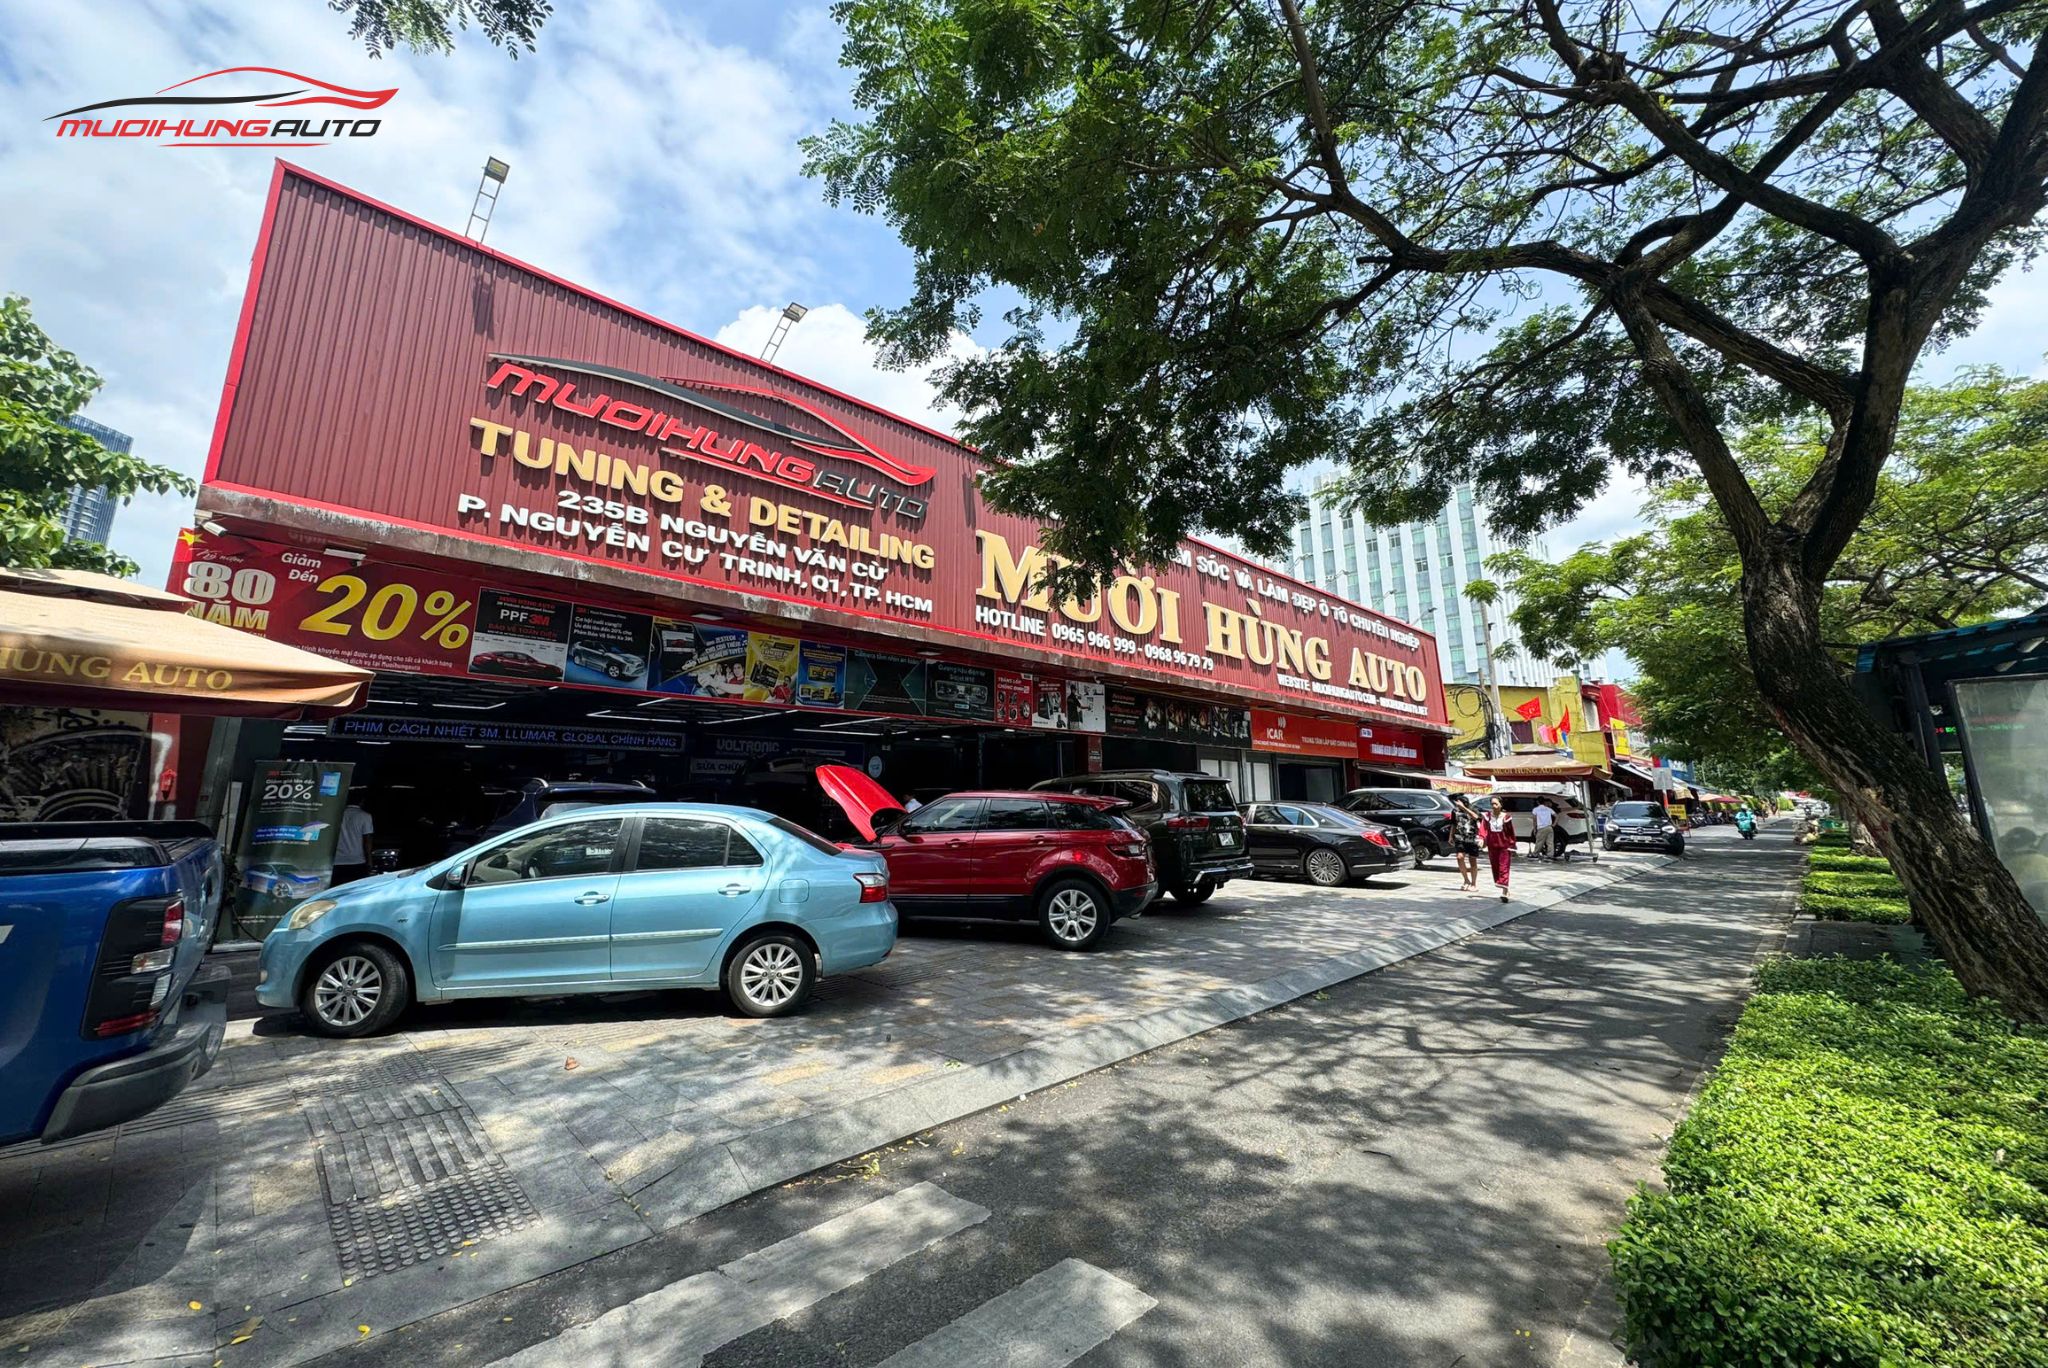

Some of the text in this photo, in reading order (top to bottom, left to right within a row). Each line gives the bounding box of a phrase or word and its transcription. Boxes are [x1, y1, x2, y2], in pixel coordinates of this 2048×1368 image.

[469, 417, 935, 570] TUNING & DETAILING
[457, 493, 491, 519] P.
[500, 503, 650, 554] NGUYỄN
[720, 552, 808, 589] TRINH,
[885, 590, 933, 613] HCM
[557, 489, 890, 581] 235B NGUYỄN VĂN CỪ
[183, 560, 277, 605] 80
[281, 552, 322, 569] Giảm
[288, 569, 319, 583] Đến
[299, 573, 473, 650] 20%
[500, 609, 551, 627] PPF 3M
[1196, 554, 1230, 581] SÓC
[1233, 567, 1254, 592] VÀ
[1257, 578, 1289, 604] LÀM
[1291, 591, 1317, 615] ĐẸP
[1319, 599, 1330, 617] Ô
[1331, 606, 1348, 624] TÔ
[1350, 613, 1389, 639] CHUYÊN
[1389, 628, 1420, 652] NGHIỆP
[975, 605, 1047, 637] HOTLINE
[1052, 622, 1085, 644] 0965
[1087, 631, 1111, 650] 966
[1113, 636, 1136, 655] 999
[1144, 643, 1172, 662] 0968
[1174, 650, 1187, 665] 96
[1186, 653, 1200, 668] 79
[1200, 656, 1214, 671] 79
[1202, 598, 1332, 680] HÙNG
[1349, 647, 1427, 702] AUTO
[0, 643, 233, 690] ÙNG AUTO
[344, 721, 383, 733] PHIM
[562, 731, 608, 744] GLOBAL
[716, 738, 780, 752] VOLTRONIC
[1266, 727, 1284, 740] ICAR
[263, 784, 314, 800] 20%
